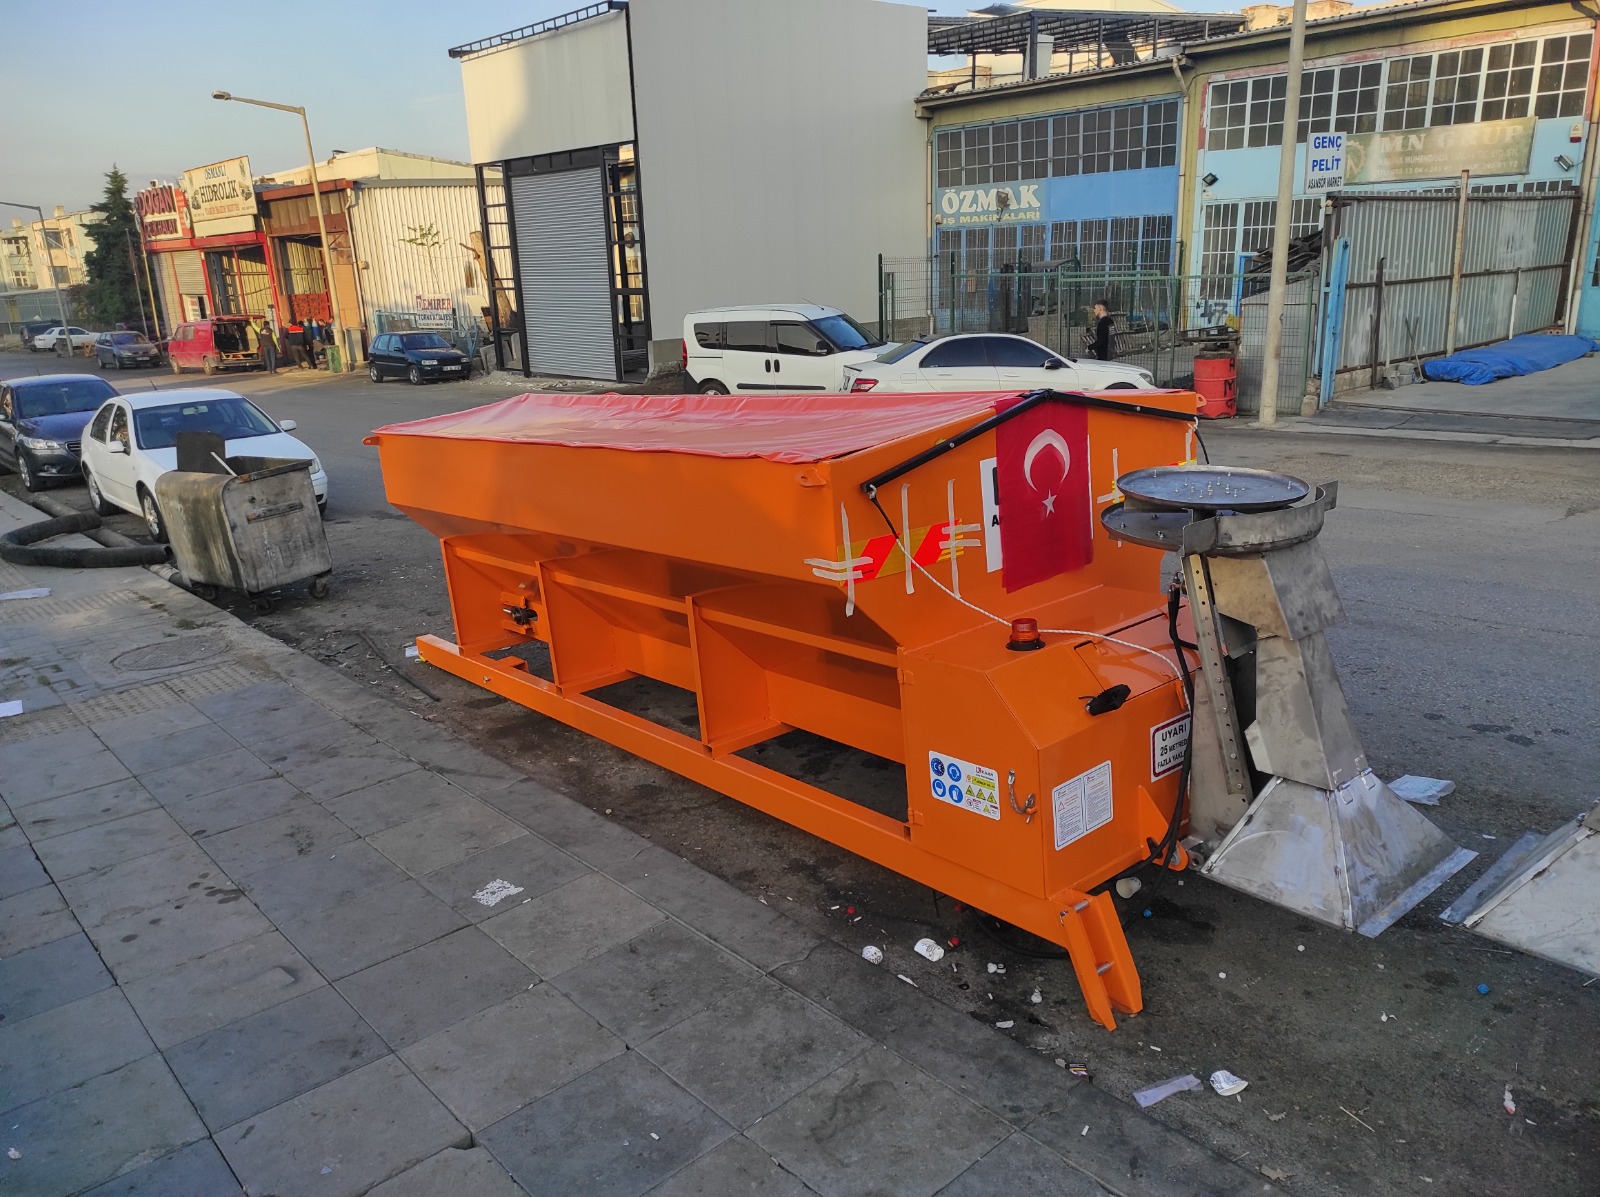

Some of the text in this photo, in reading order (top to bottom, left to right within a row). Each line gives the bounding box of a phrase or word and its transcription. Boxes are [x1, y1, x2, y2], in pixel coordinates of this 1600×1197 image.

[1313, 135, 1342, 151] GENÇ
[1380, 133, 1427, 154] MN
[1311, 155, 1341, 172] PELİT
[204, 165, 227, 180] OSMANLI
[1327, 176, 1342, 188] MARKET
[941, 184, 1040, 215] ÖZMAK
[416, 295, 452, 310] DEMİRER
[1161, 723, 1187, 741] UYARI
[1160, 738, 1188, 757] 25 METRED
[1157, 751, 1185, 770] FAZLA YAKL
